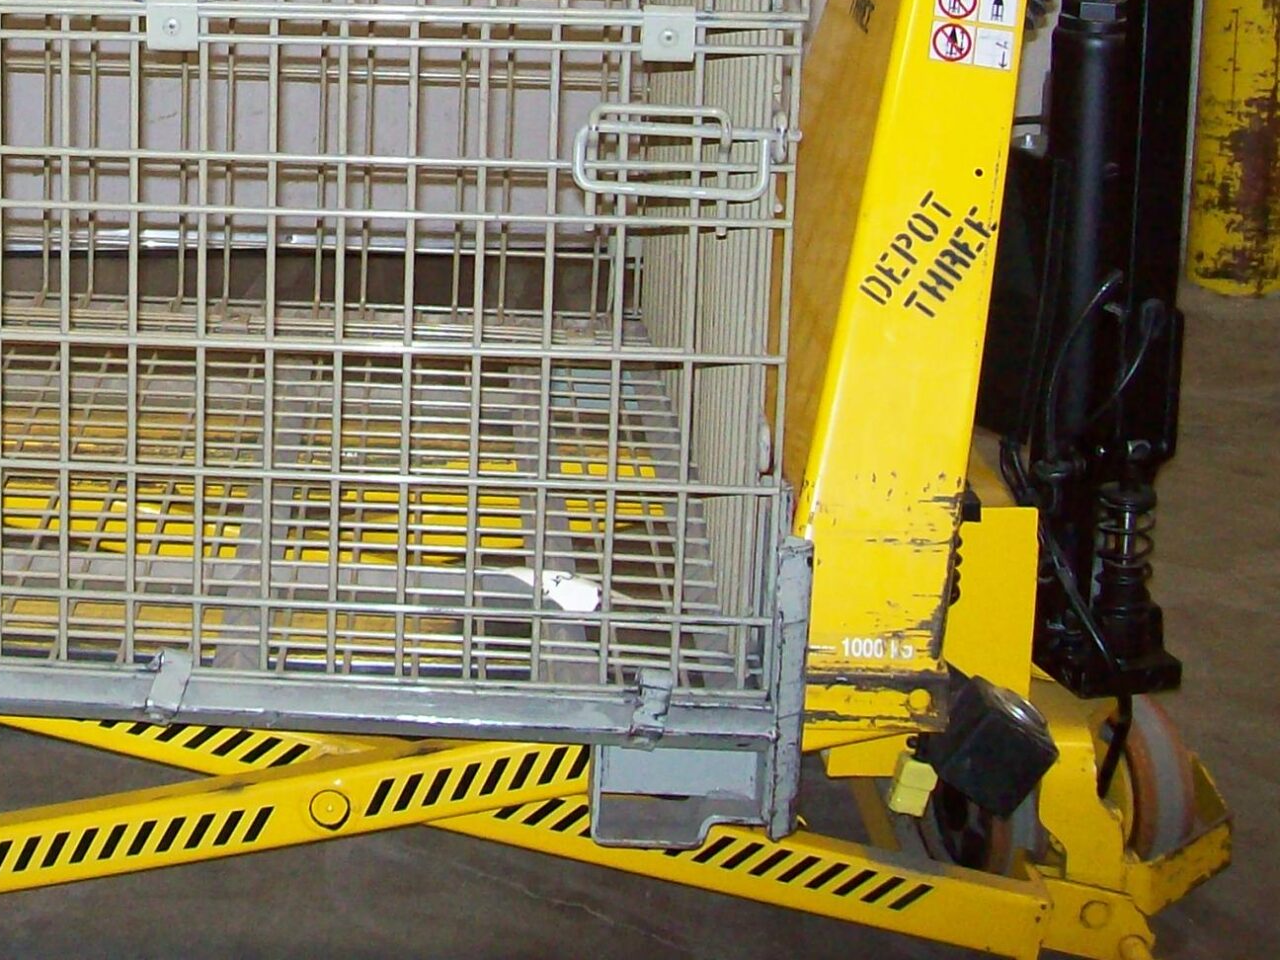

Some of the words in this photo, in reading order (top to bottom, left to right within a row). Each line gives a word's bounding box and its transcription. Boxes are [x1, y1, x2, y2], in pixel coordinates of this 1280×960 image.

[859, 190, 952, 305] DEPOT
[904, 206, 997, 318] THREE
[841, 637, 885, 659] 1000
